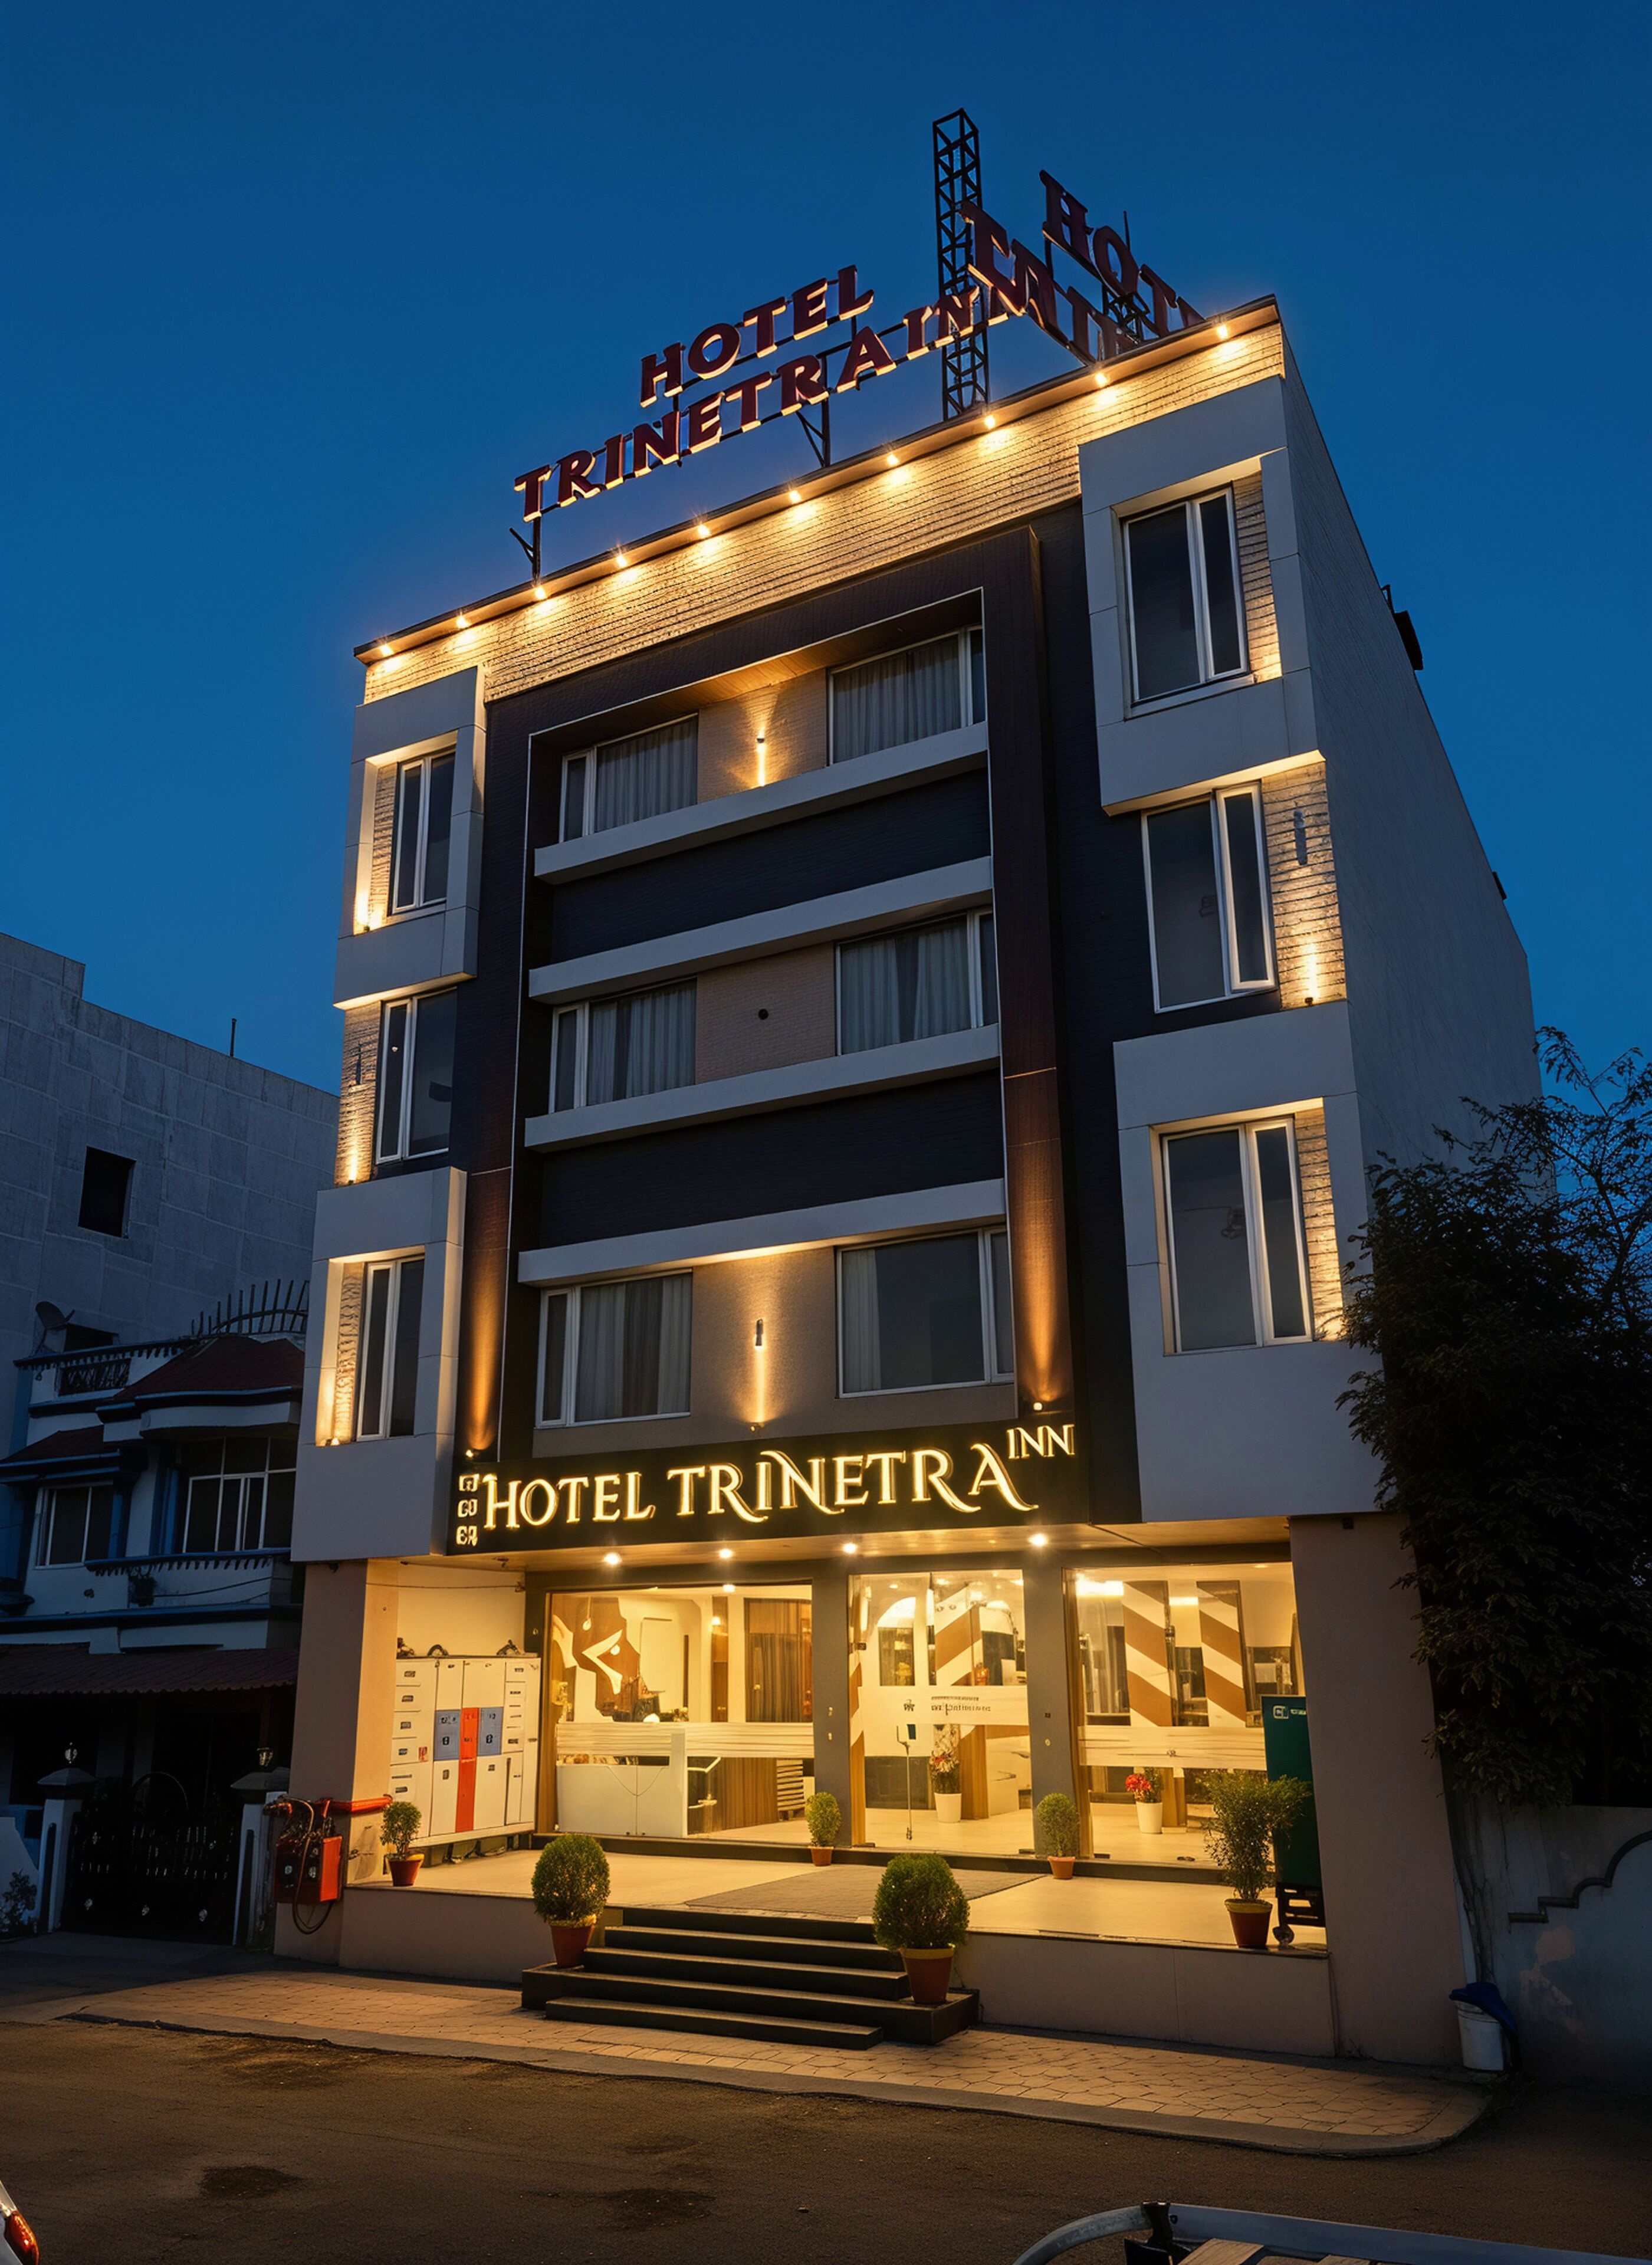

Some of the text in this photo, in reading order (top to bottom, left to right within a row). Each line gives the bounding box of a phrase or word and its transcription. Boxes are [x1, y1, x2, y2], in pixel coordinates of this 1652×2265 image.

[640, 264, 875, 408] HOTEL
[514, 326, 896, 523] TRINETRA
[481, 1471, 656, 1529] HOTEL
[666, 1443, 1040, 1523] TRINETRA
[1006, 1423, 1075, 1460] INN
